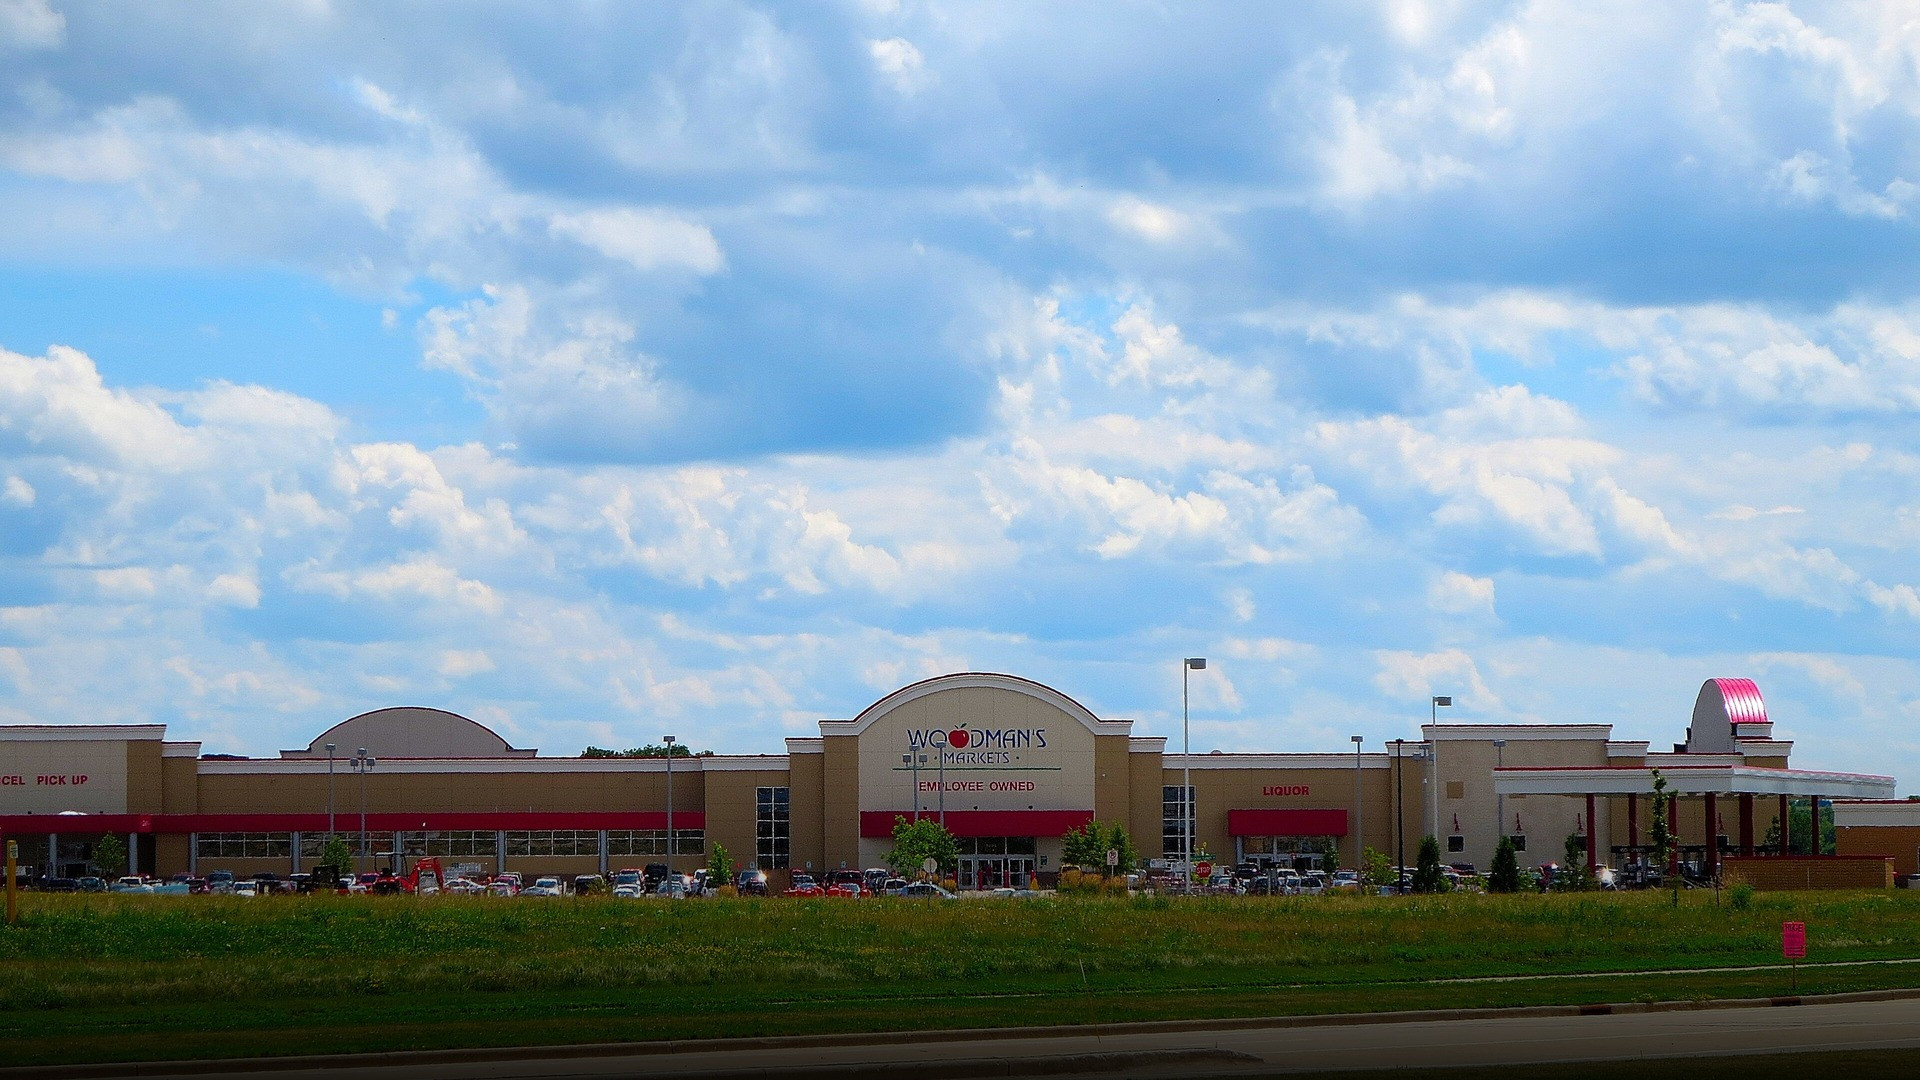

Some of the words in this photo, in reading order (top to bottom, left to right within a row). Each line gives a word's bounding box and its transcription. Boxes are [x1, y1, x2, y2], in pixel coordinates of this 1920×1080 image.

[907, 728, 1047, 749] WOODMAN'S
[944, 752, 1010, 764] MARKETS
[0, 775, 26, 786] CEL
[37, 775, 67, 786] PICK
[72, 775, 89, 786] UP
[918, 781, 984, 792] EMPLOYEE
[989, 781, 1035, 792] OWNED
[1262, 785, 1310, 796] LIQUOR
[1196, 866, 1211, 875] STOP
